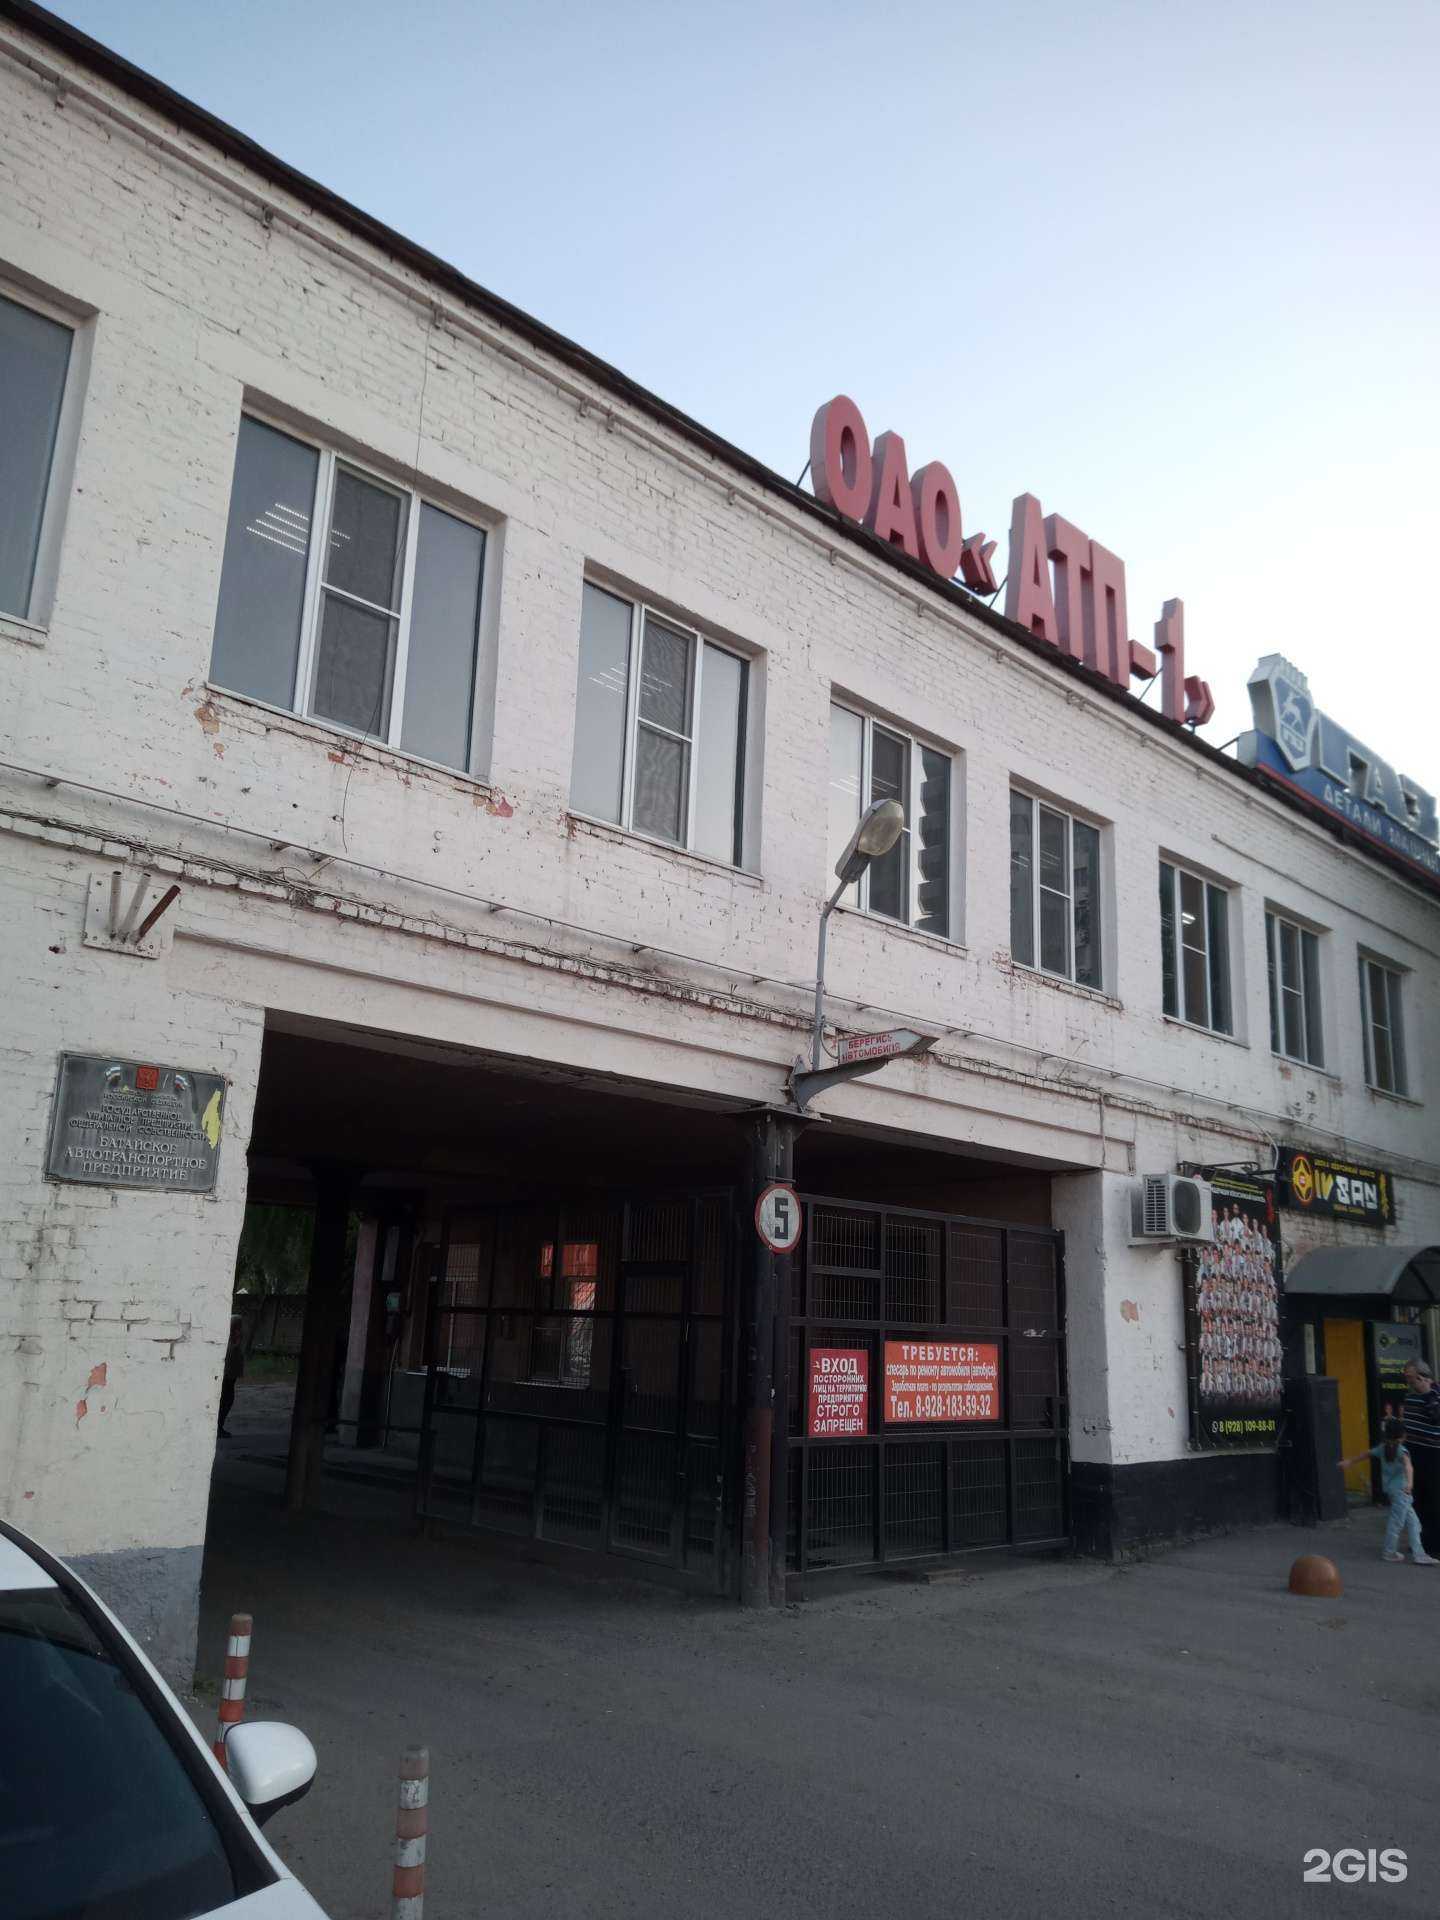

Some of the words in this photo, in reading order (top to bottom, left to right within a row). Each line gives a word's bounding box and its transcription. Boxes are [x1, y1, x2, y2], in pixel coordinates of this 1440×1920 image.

[810, 394, 962, 579] ОАО
[1323, 783, 1382, 837] ДЕТАЛИ
[848, 1034, 893, 1050] БЕРЕГИСЬ
[100, 1136, 177, 1154] БАТАЙСКОЕ
[64, 1146, 208, 1170] АВТОТРАНСПОРТНОЕ
[82, 1161, 188, 1180] ПРЕДПРИЯТИЕ
[774, 1197, 789, 1240] 5
[902, 1345, 979, 1362] ТРЕБУЕТСЯ:
[821, 1358, 858, 1375] ВХОД
[814, 1374, 864, 1383] ПОСТОРОННИХ
[813, 1384, 827, 1393] ЛИЦ
[828, 1384, 835, 1392] НА
[836, 1384, 867, 1393] ТЕРРИТОРИЮ
[818, 1393, 864, 1403] ПРЕДПРИЯТИЯ
[817, 1404, 860, 1417] СТРОГО
[890, 1396, 913, 1418] Тел.
[813, 1419, 864, 1433] ЗАПРЕЩЕН
